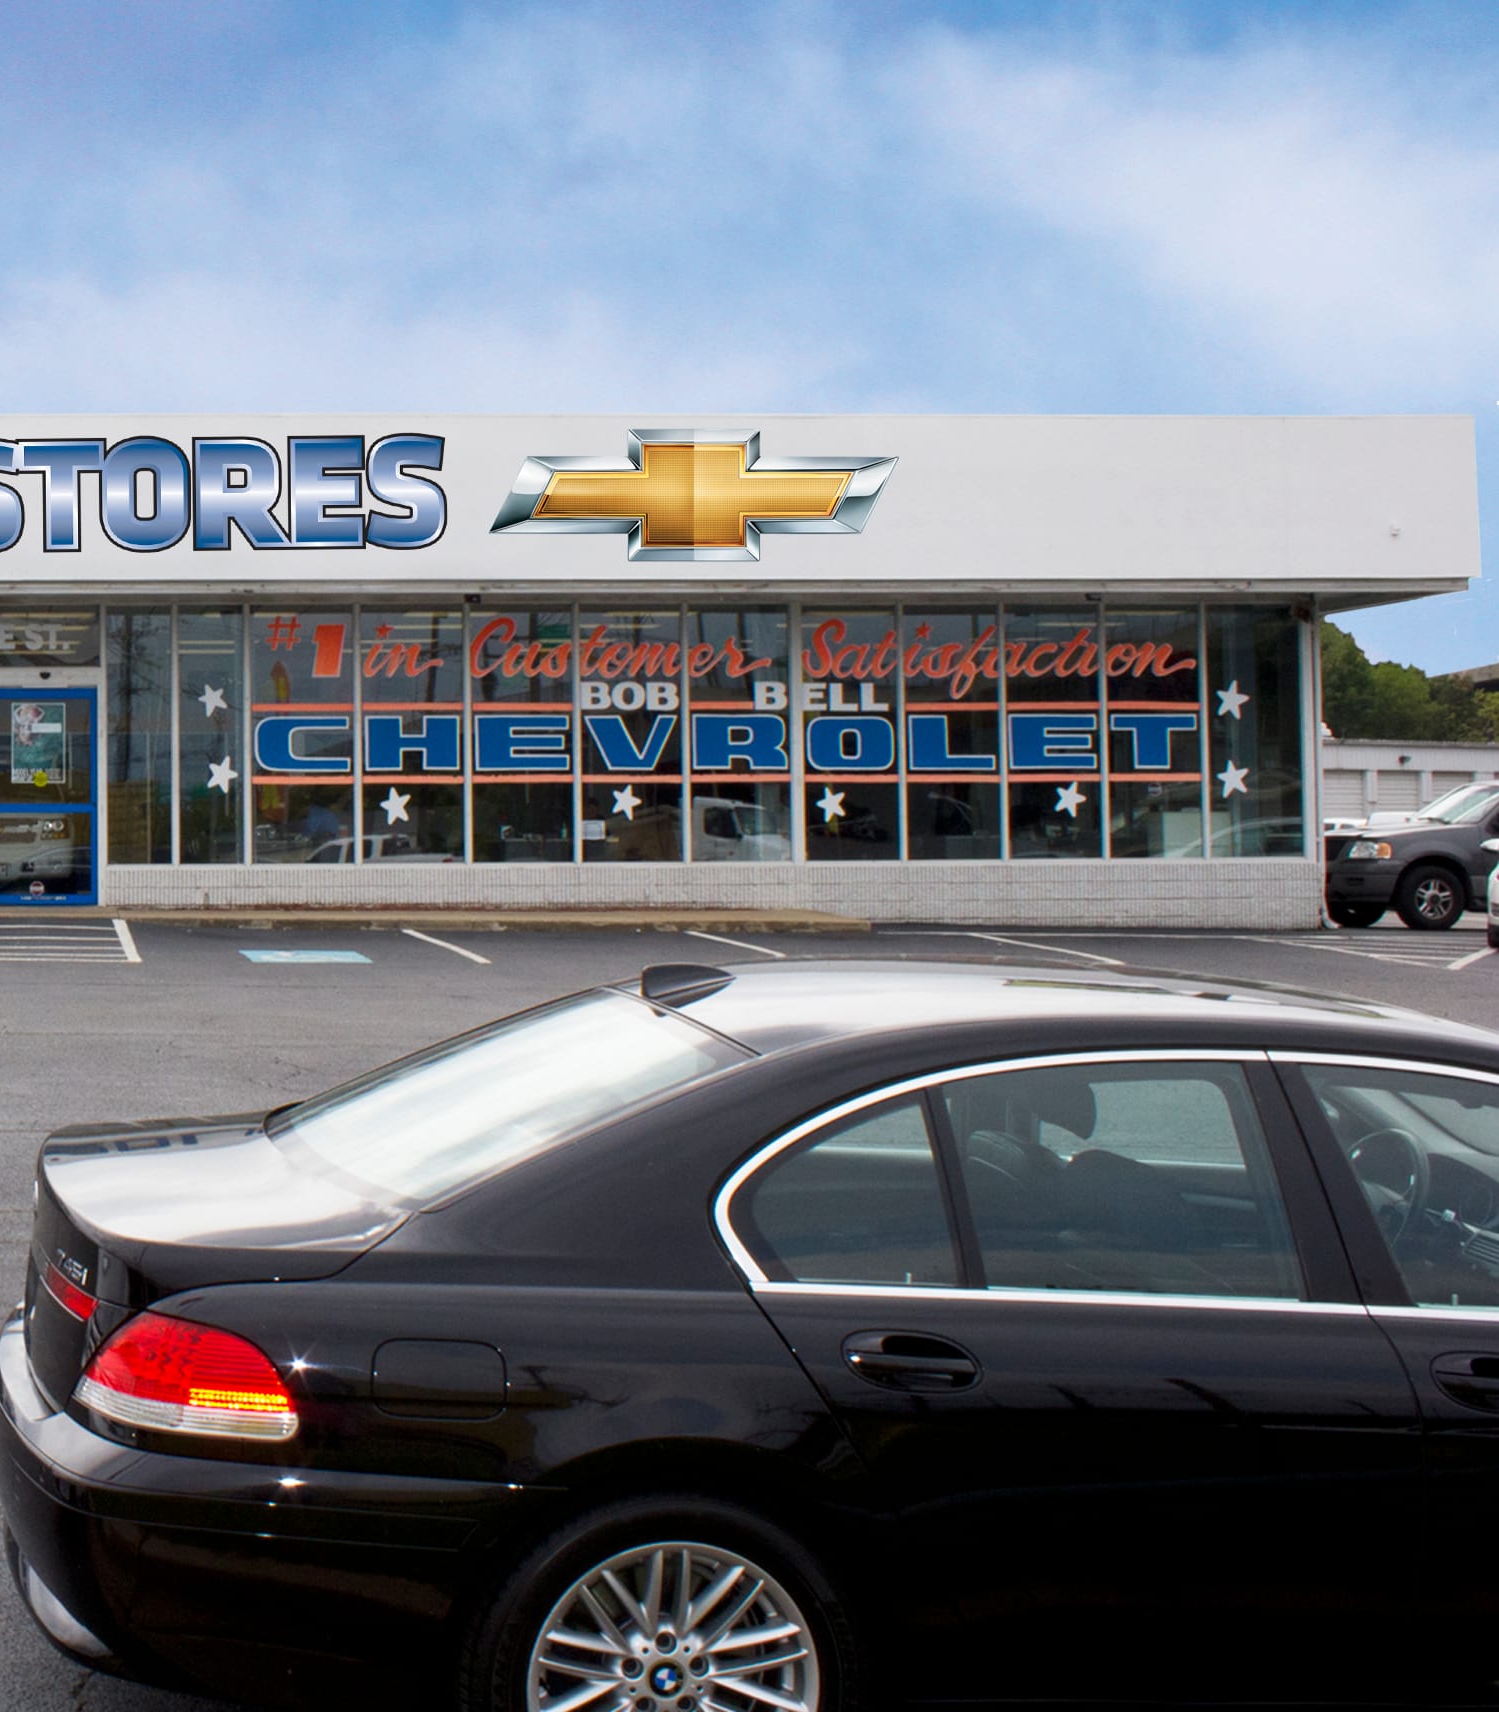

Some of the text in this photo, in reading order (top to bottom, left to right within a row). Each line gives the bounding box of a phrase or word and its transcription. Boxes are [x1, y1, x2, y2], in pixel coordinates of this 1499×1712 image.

[24, 624, 70, 650] ST.
[363, 624, 443, 678] in
[468, 616, 773, 679] Customer
[802, 618, 1197, 698] Satisfaction
[580, 680, 889, 712] BOB BELL
[254, 712, 1198, 772] CHEVROLET
